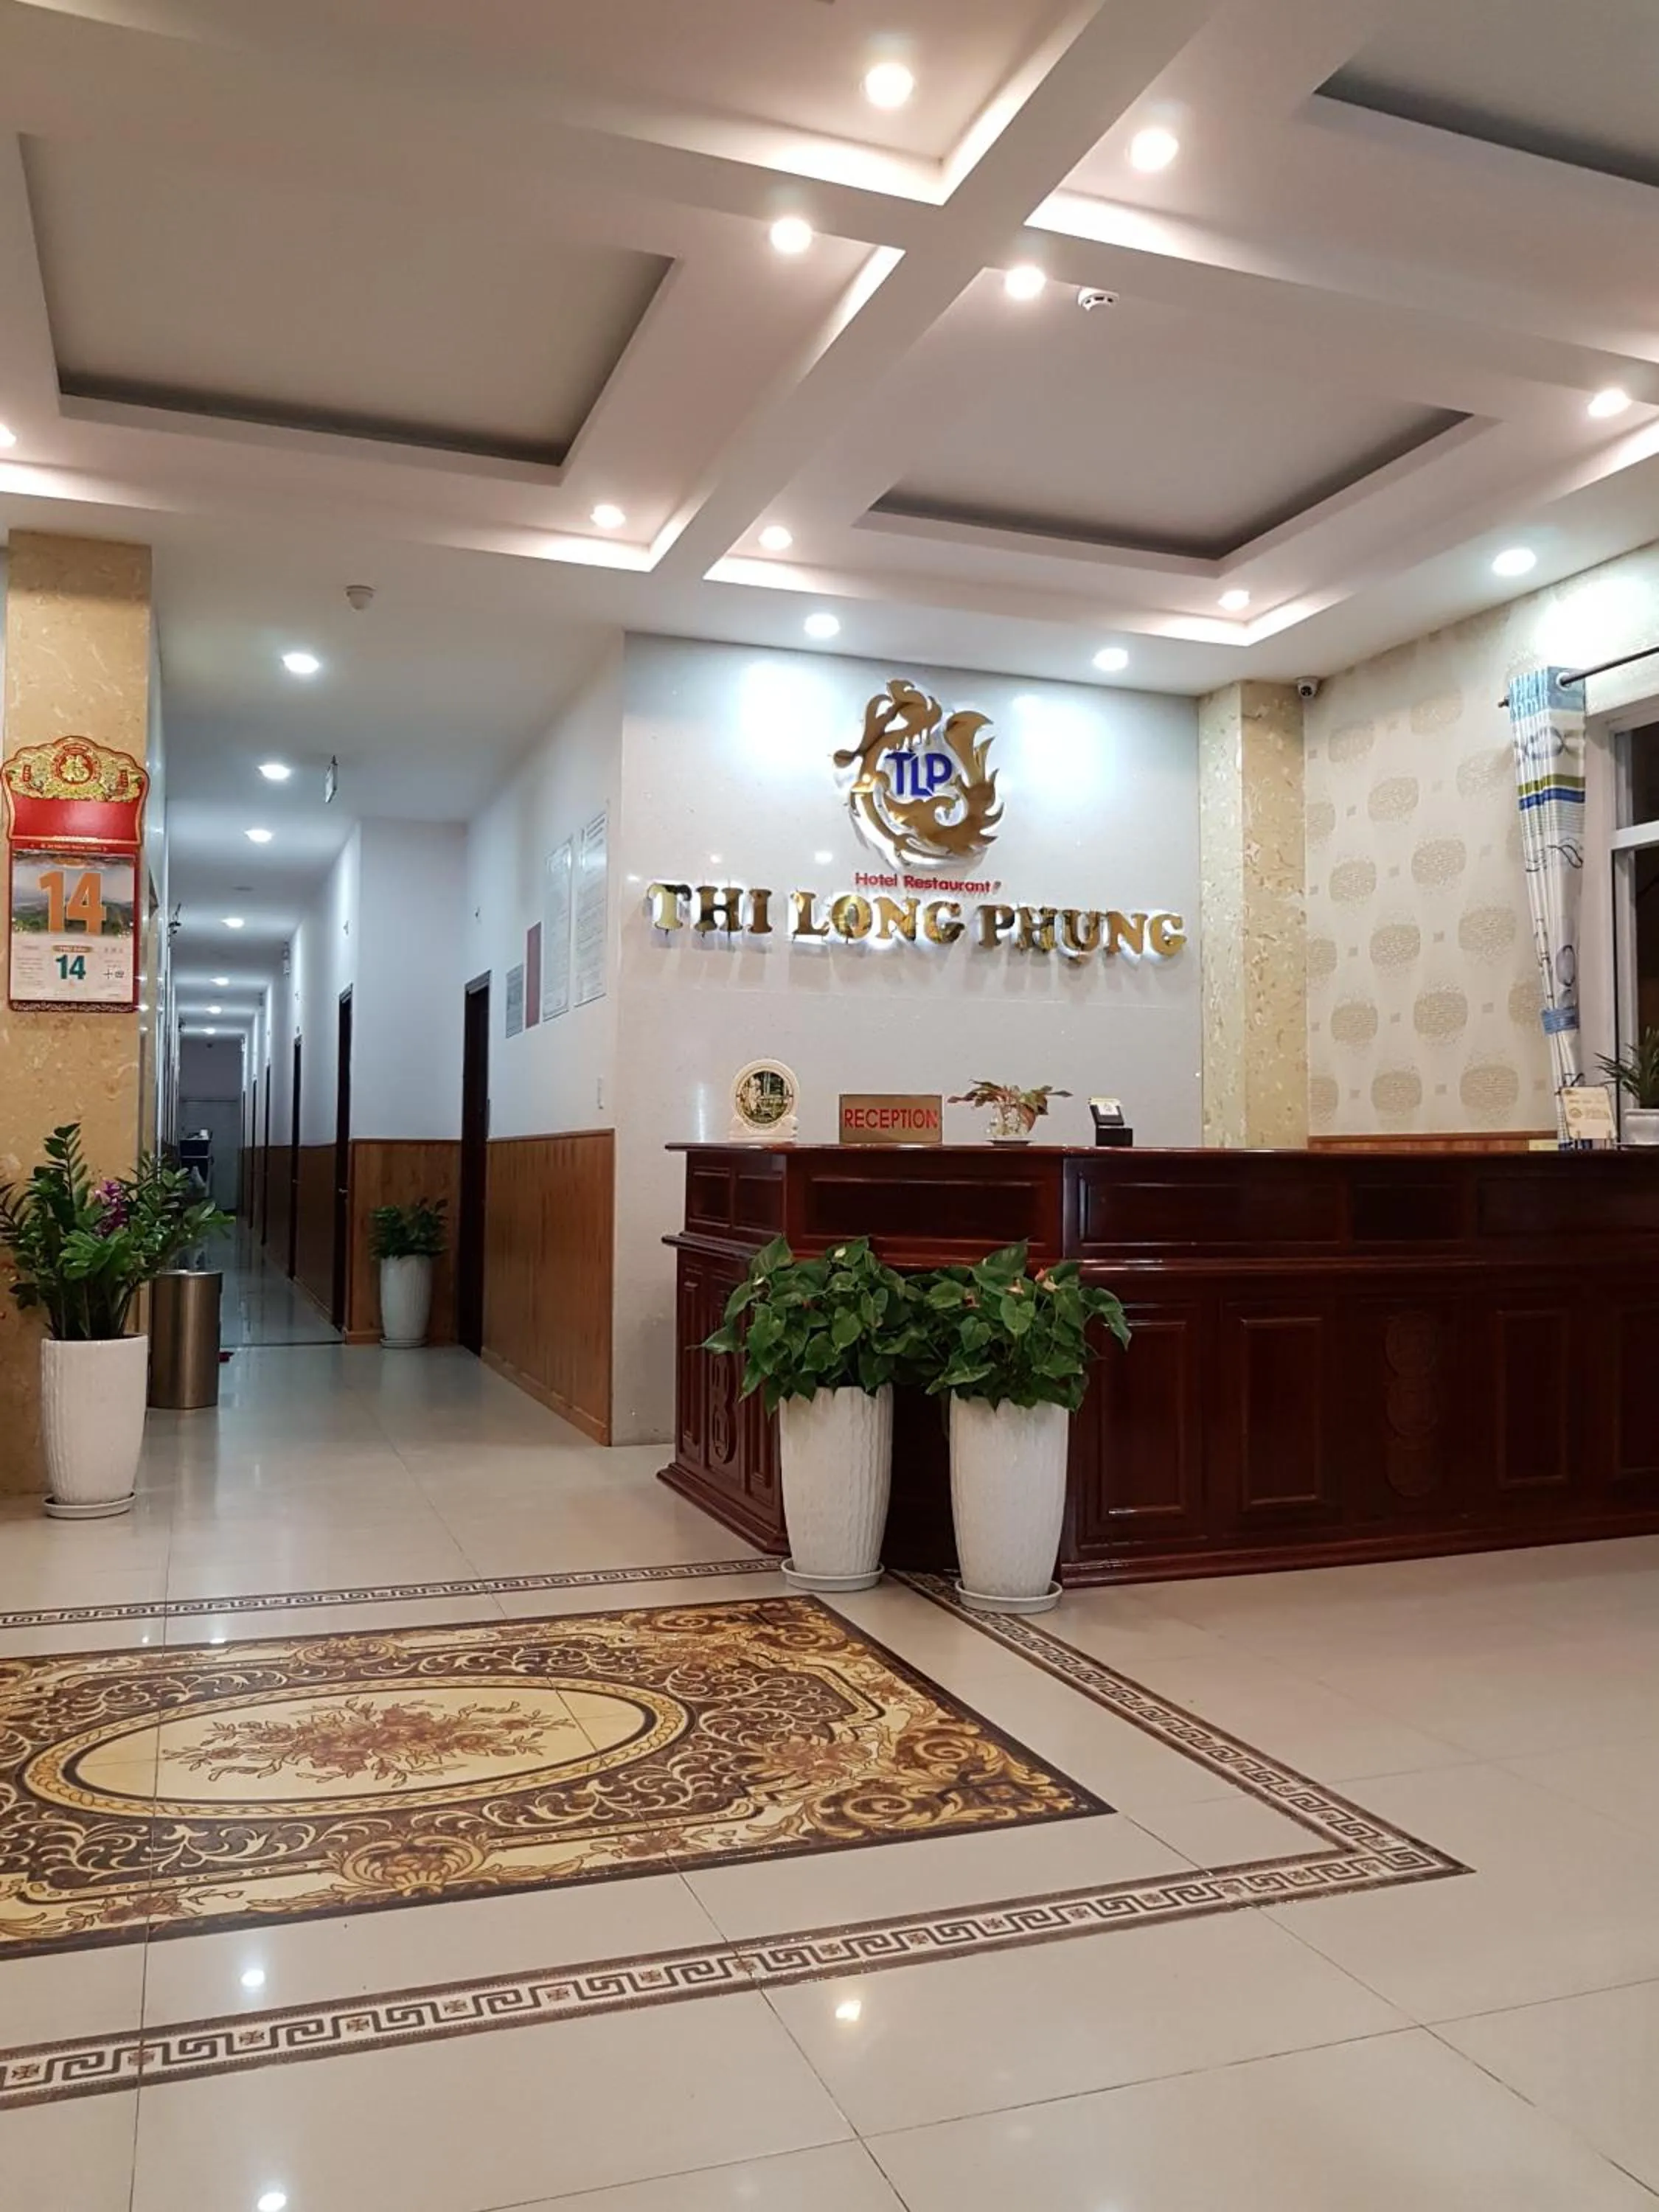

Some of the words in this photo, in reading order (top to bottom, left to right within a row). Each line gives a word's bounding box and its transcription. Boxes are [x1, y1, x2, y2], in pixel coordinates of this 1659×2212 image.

[885, 750, 952, 796] TLP
[855, 873, 897, 887] Hotel
[902, 875, 991, 892] Restaurant
[39, 871, 107, 935] 14
[647, 883, 772, 933] THI
[790, 889, 964, 945] LONG
[55, 954, 86, 980] 14
[844, 1108, 939, 1129] RECEPTION
